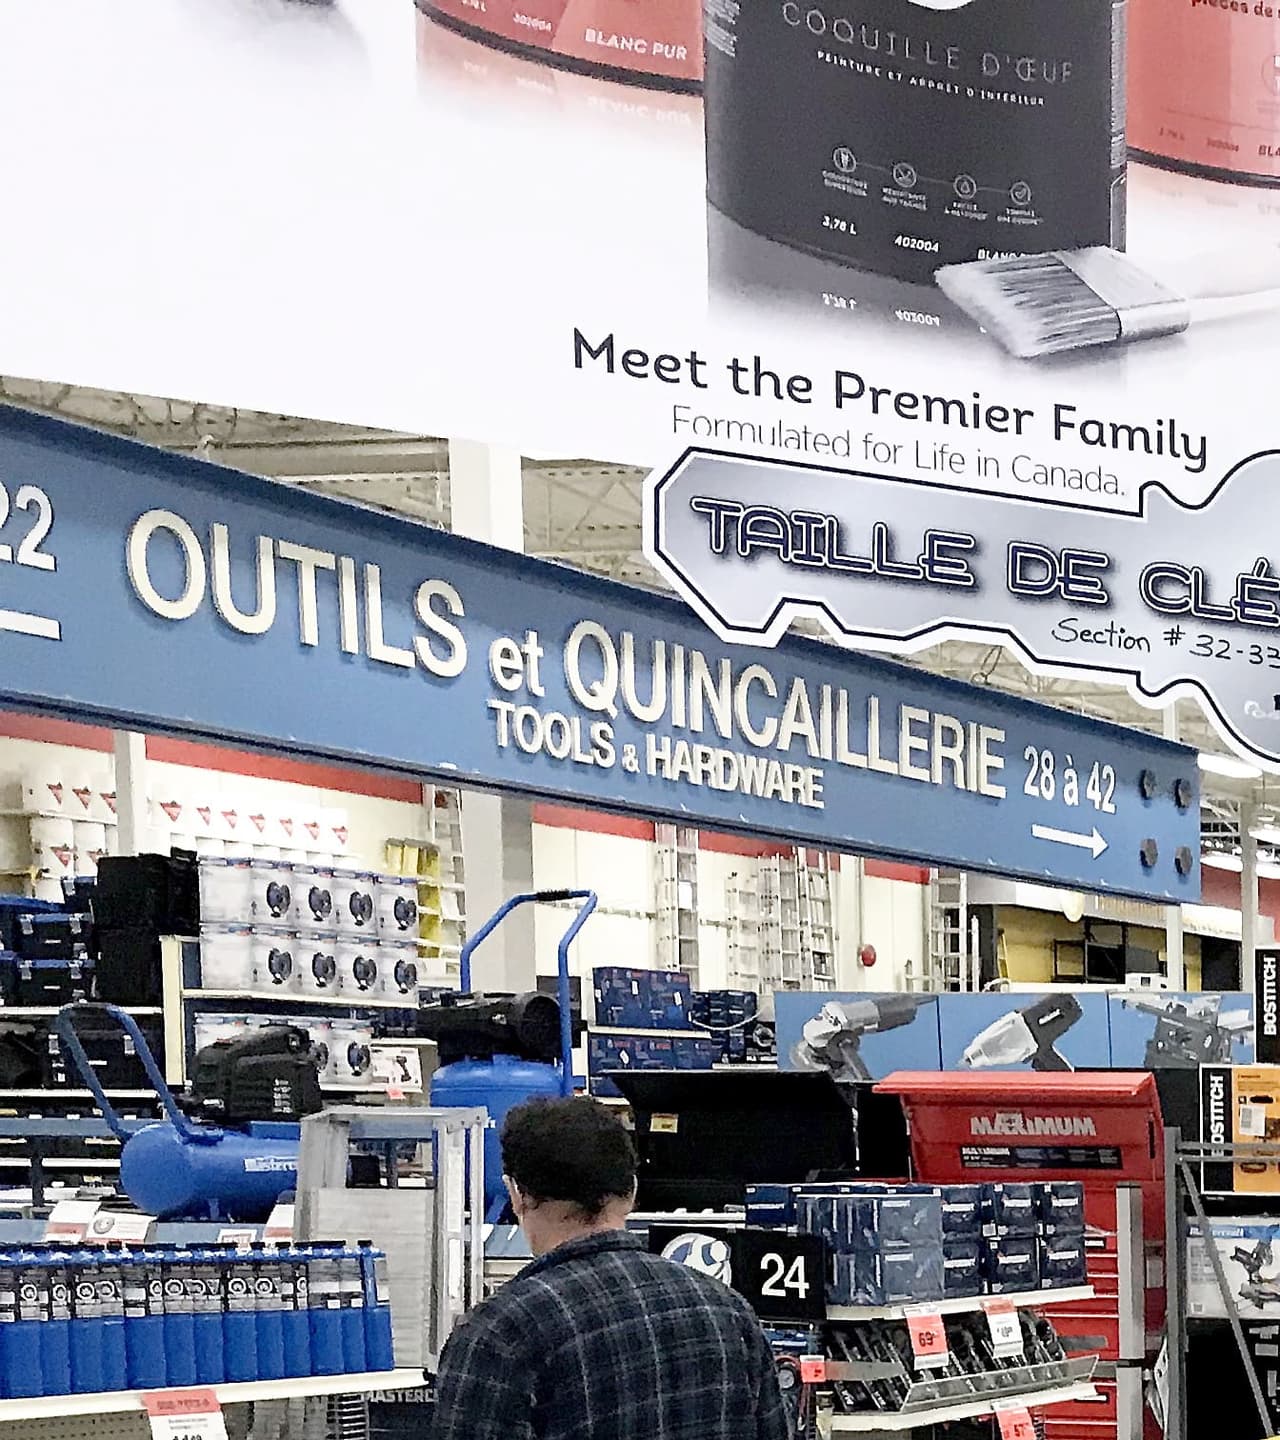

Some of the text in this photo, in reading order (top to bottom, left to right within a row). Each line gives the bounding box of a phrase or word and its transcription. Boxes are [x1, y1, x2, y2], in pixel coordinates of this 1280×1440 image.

[585, 28, 687, 61] BLANC PUR
[783, 2, 961, 70] COQUILLE
[1253, 0, 1273, 18] de
[573, 327, 1206, 474] Meet the Premier Family
[673, 404, 1125, 496] Formulated for Life in Canada.
[690, 496, 976, 586] TAILLE
[1007, 541, 1110, 605] DE
[126, 507, 1117, 815] OUTILS et QUINCAILLERIE 28 à 42
[1050, 617, 1152, 653] Section
[1163, 624, 1187, 647] #
[487, 698, 825, 809] TOOLS & HARDWARE
[1263, 956, 1277, 1036] BOSTITCH
[760, 1253, 810, 1299] 24
